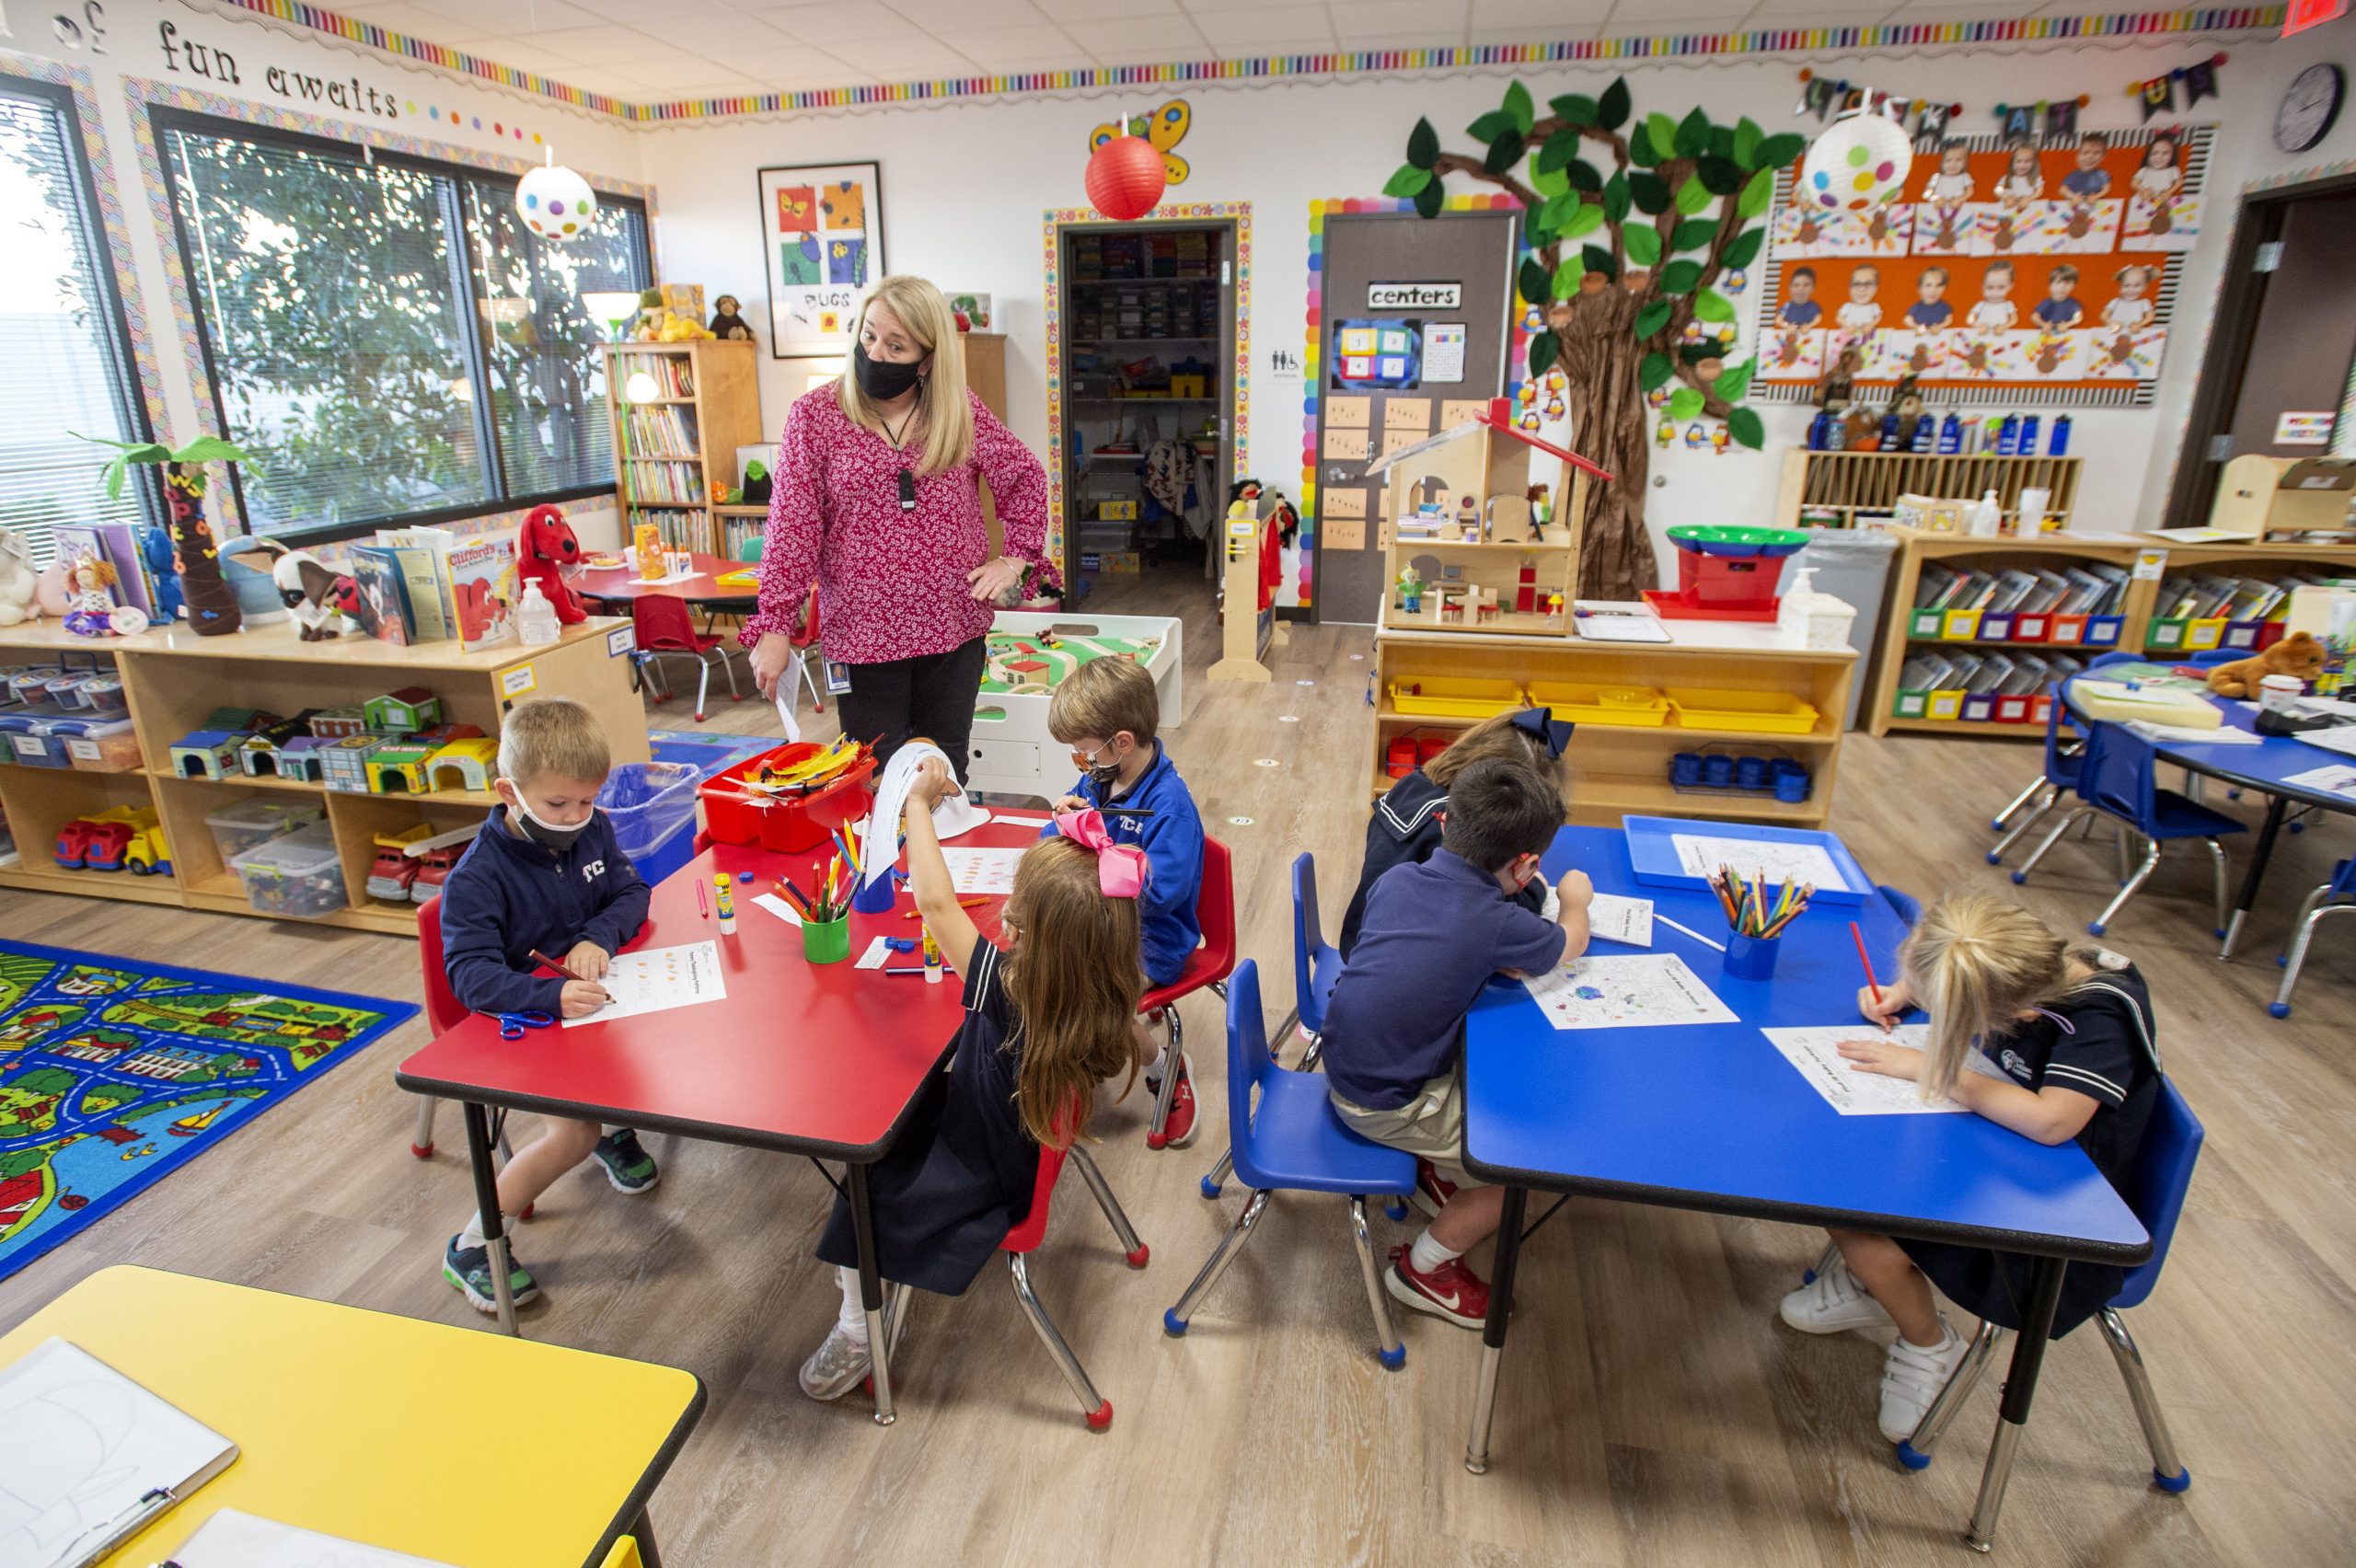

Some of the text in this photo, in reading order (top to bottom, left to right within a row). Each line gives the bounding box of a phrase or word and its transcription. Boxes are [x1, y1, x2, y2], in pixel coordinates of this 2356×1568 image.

[52, 0, 109, 55] of
[159, 19, 241, 86] fun
[266, 64, 398, 120] awaits
[2009, 103, 2069, 132] AT
[803, 292, 850, 310] BUGS
[1371, 286, 1455, 305] centers
[449, 543, 495, 566] Clifford's
[582, 859, 606, 883] TC
